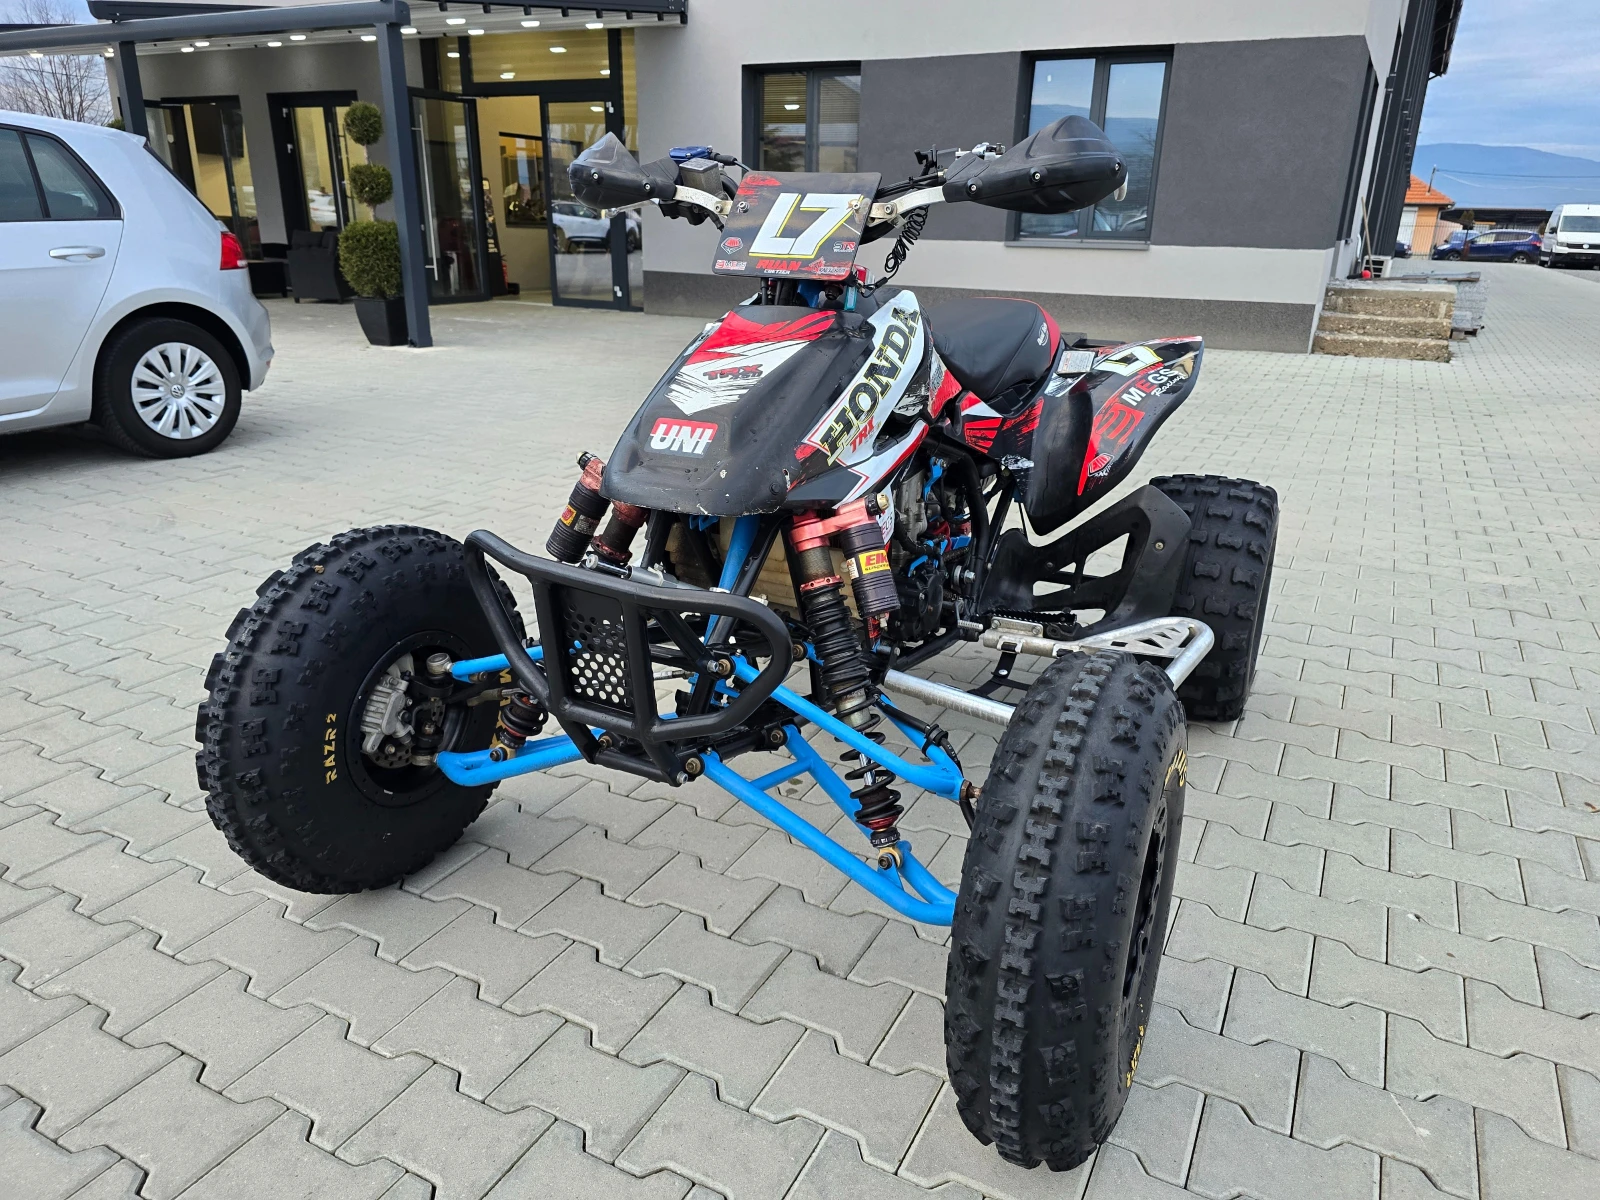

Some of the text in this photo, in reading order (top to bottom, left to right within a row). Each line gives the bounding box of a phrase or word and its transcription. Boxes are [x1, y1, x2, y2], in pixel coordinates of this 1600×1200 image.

[756, 259, 802, 271] RUAN
[819, 307, 920, 467] HONDA
[1121, 368, 1179, 407] MEGS
[650, 424, 714, 455] UNI
[323, 713, 338, 785] RAZR 2
